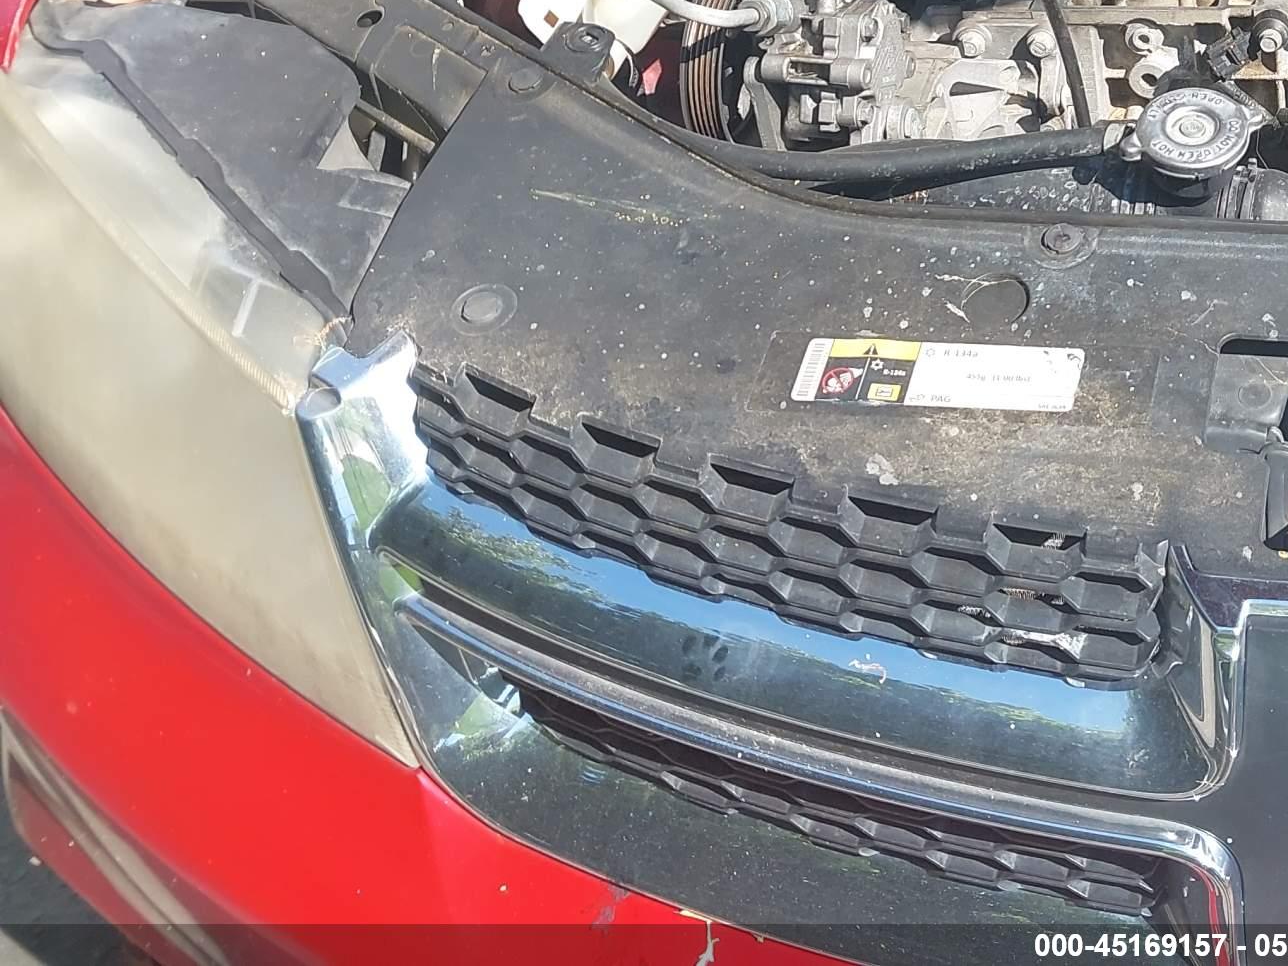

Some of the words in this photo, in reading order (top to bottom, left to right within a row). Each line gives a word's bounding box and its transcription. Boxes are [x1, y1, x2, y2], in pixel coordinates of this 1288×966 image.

[1150, 139, 1175, 156] HOT
[1215, 134, 1235, 152] NOT
[1177, 148, 1212, 161] OPEN
[930, 394, 951, 403] PAG
